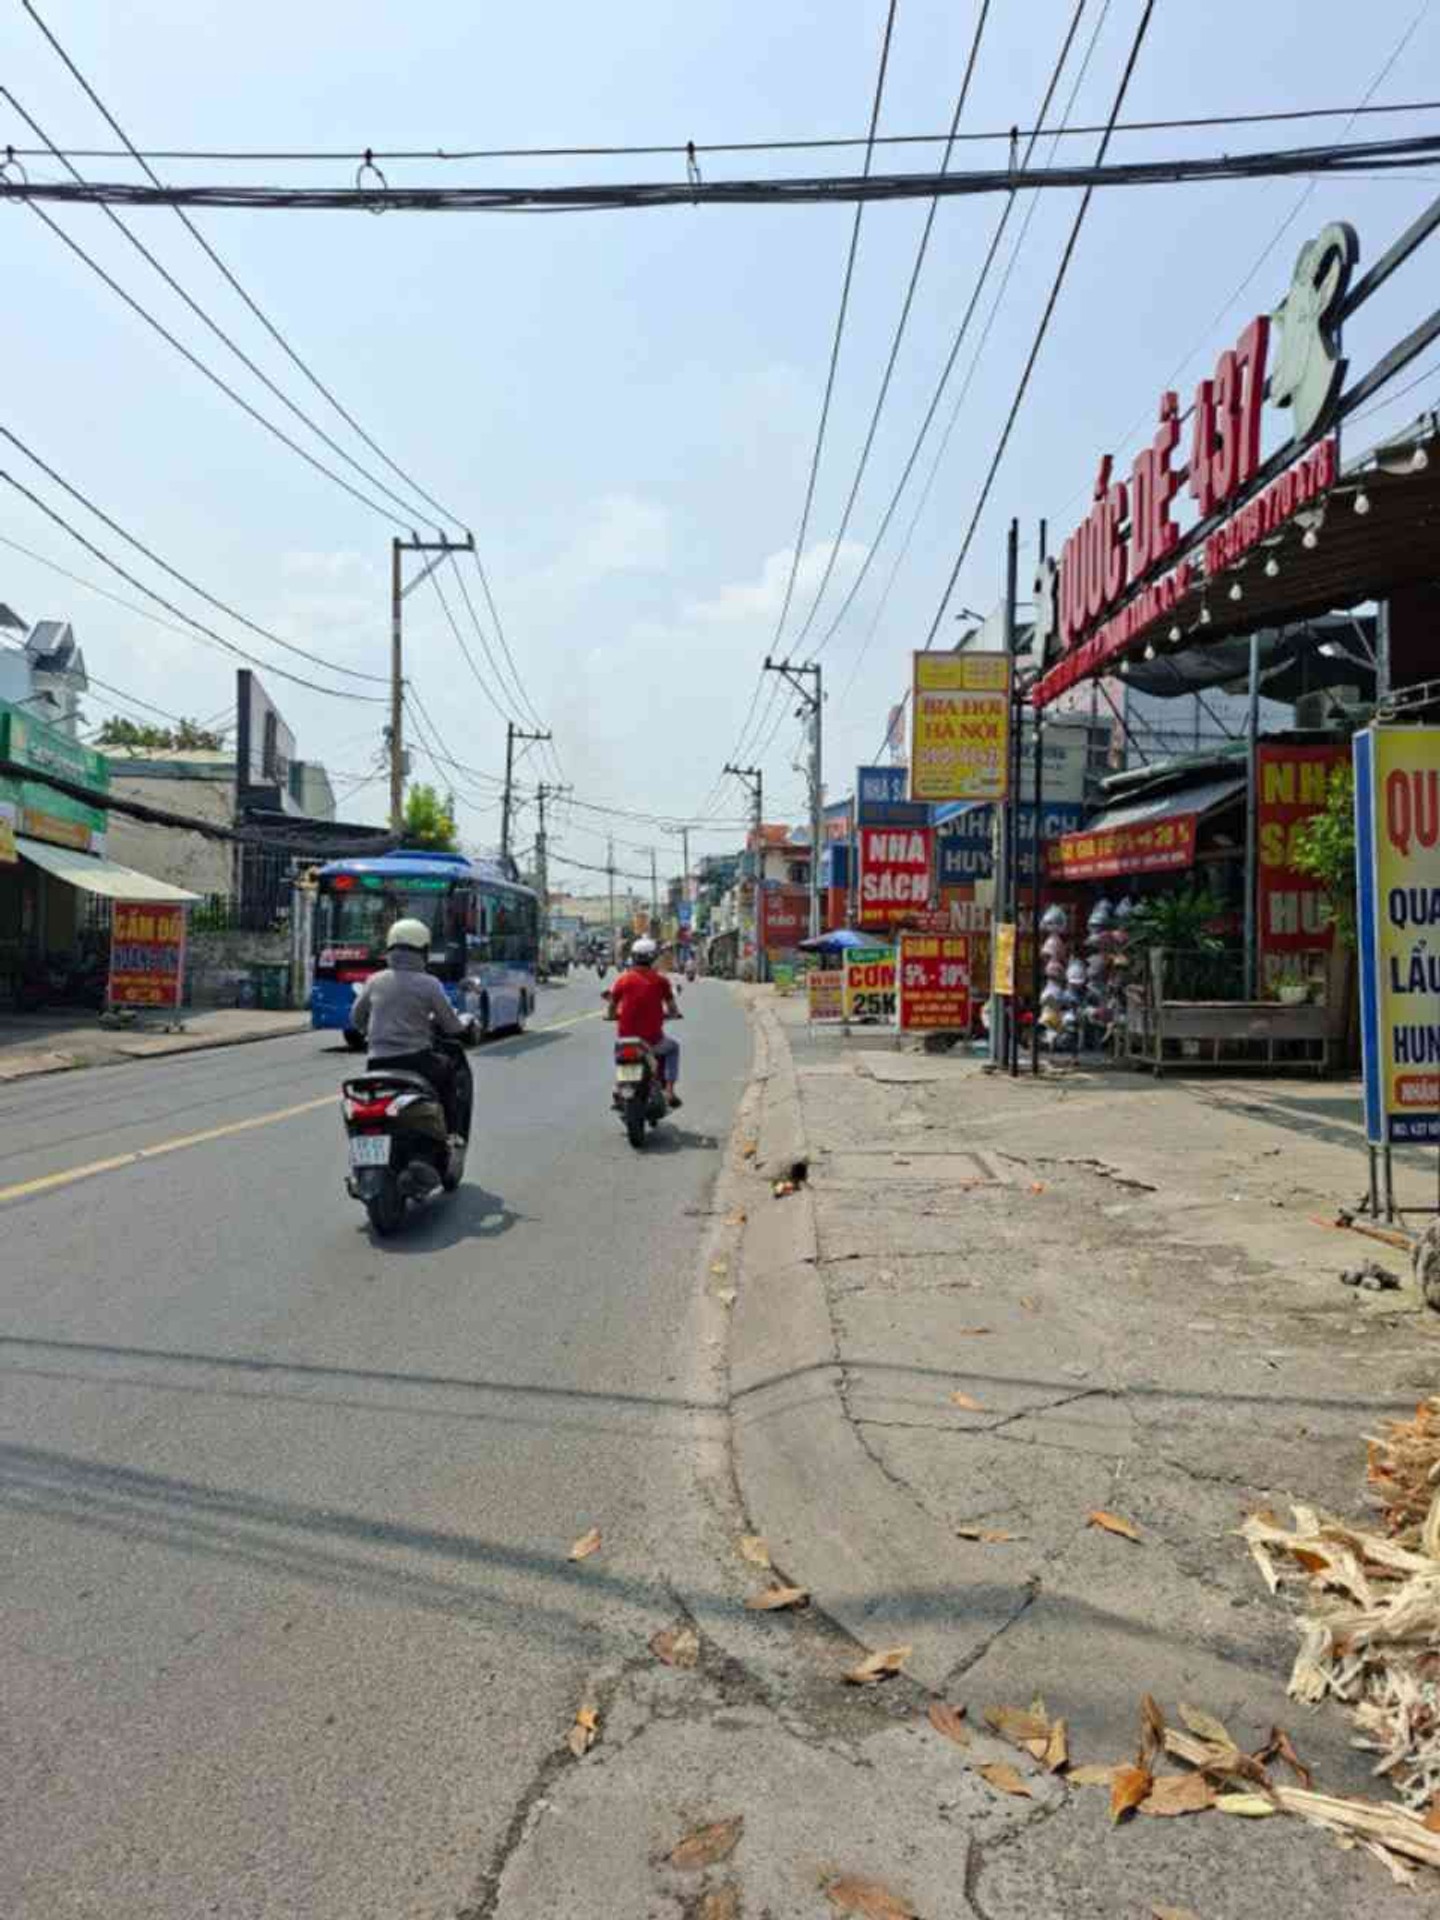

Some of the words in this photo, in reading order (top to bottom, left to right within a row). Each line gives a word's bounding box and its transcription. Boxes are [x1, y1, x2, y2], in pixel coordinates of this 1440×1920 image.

[1189, 314, 1270, 517] 437
[868, 830, 926, 862] NHÀ
[863, 869, 929, 901] SÁCH
[852, 992, 896, 1015] 25K
